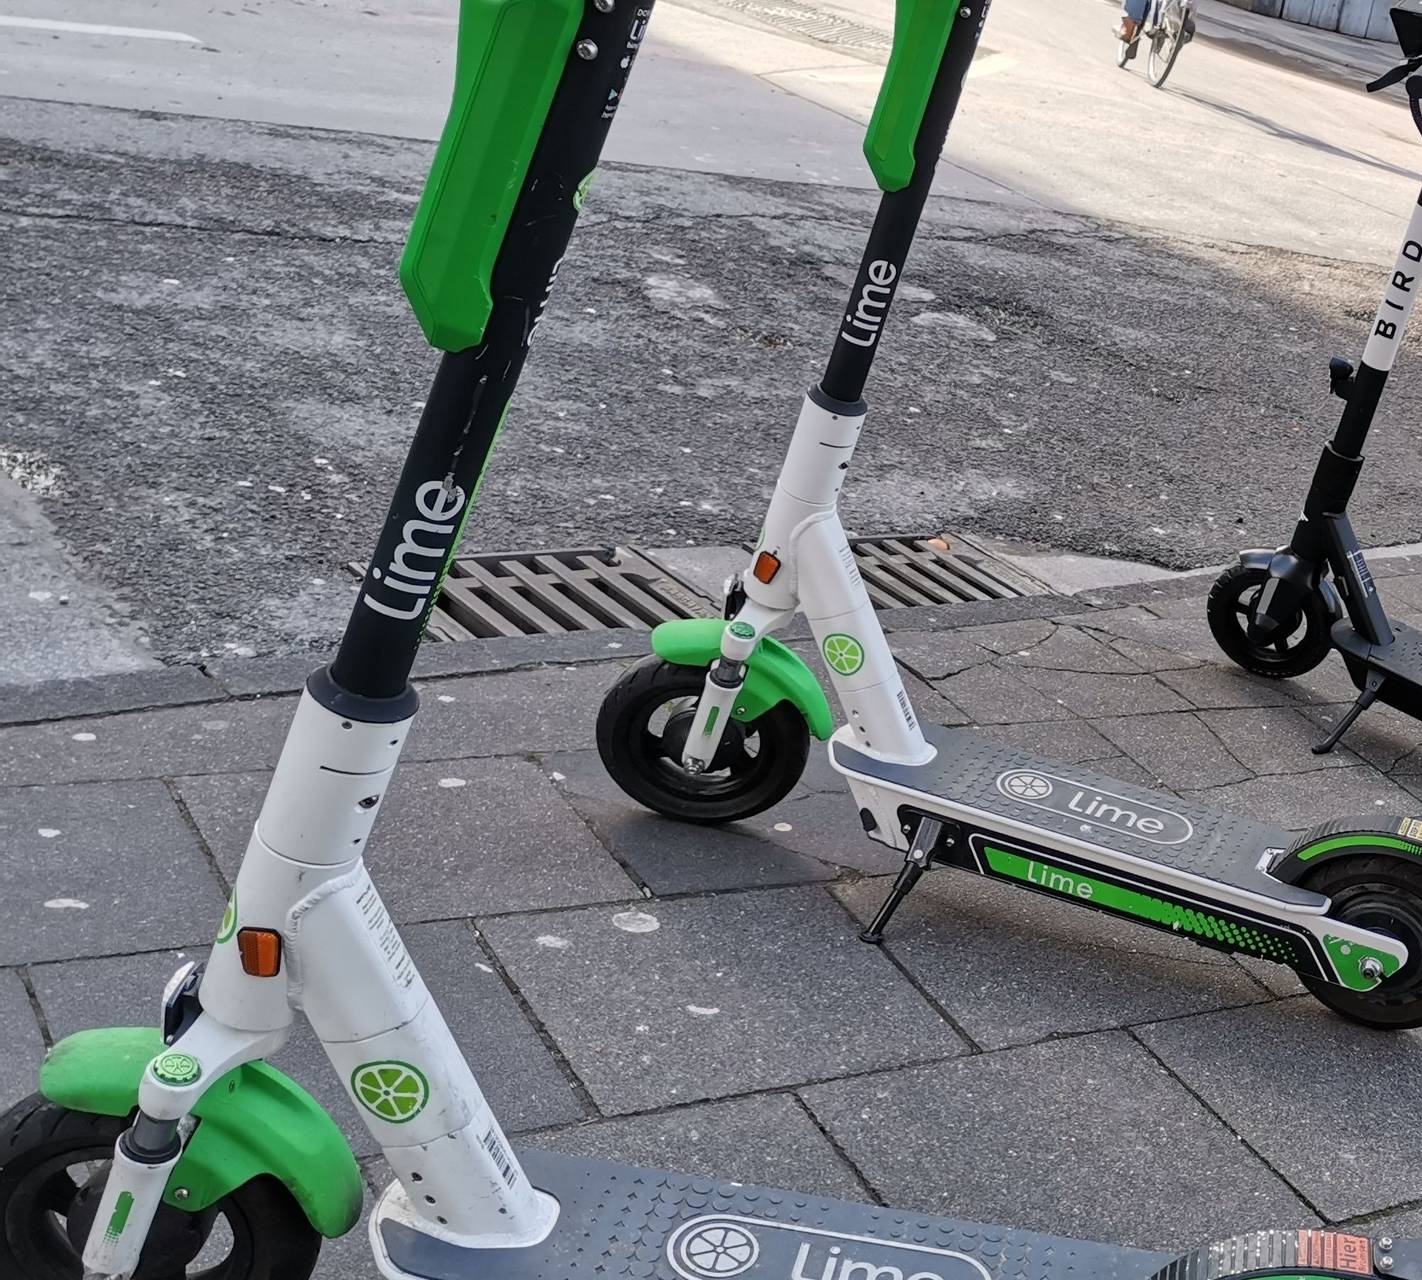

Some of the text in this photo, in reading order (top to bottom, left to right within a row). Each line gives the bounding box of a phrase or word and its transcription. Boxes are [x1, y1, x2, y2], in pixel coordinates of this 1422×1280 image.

[841, 260, 897, 347] Lime
[363, 480, 466, 621] Lime
[1068, 791, 1165, 835] Lime
[1027, 860, 1094, 900] Lime
[1340, 1237, 1357, 1270] Hier
